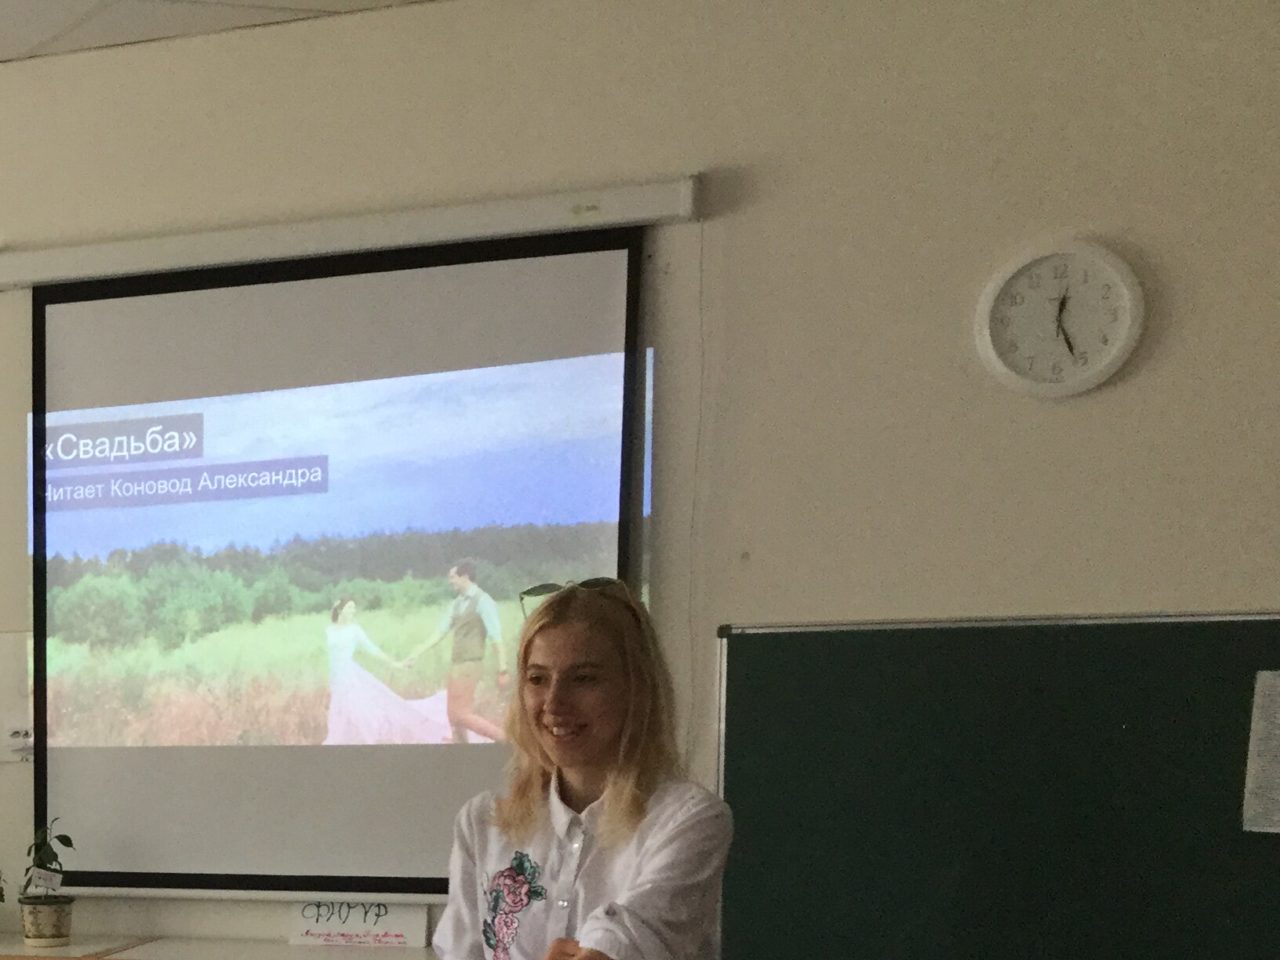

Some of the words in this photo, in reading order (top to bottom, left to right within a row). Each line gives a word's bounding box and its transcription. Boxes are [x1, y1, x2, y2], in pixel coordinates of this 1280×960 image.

[1053, 263, 1069, 279] 12
[1101, 283, 1112, 299] 2
[1026, 356, 1035, 371] 7
[111, 478, 192, 497] Коновод
[198, 465, 322, 491] Александра
